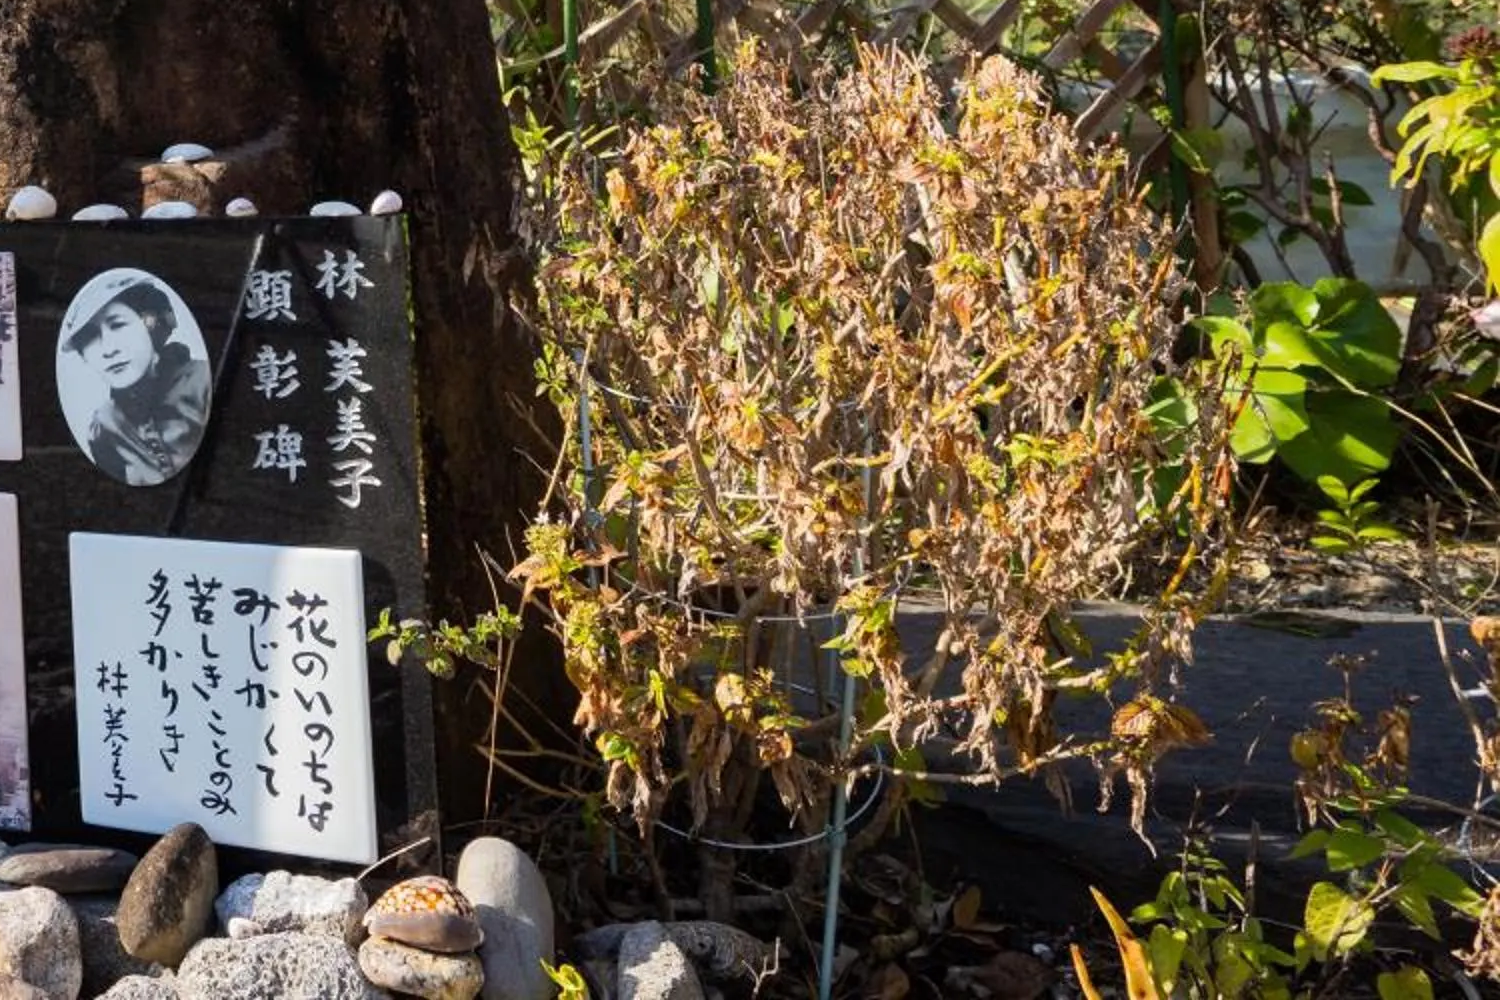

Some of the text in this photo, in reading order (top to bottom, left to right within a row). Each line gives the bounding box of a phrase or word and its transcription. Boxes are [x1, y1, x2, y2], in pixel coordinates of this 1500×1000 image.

[314, 248, 383, 510] 林 芙美子
[138, 567, 186, 773] 多かりき
[183, 572, 238, 816] 苦しきことのみ
[231, 586, 281, 798] みじかくて
[285, 588, 338, 833] 花のいのちは
